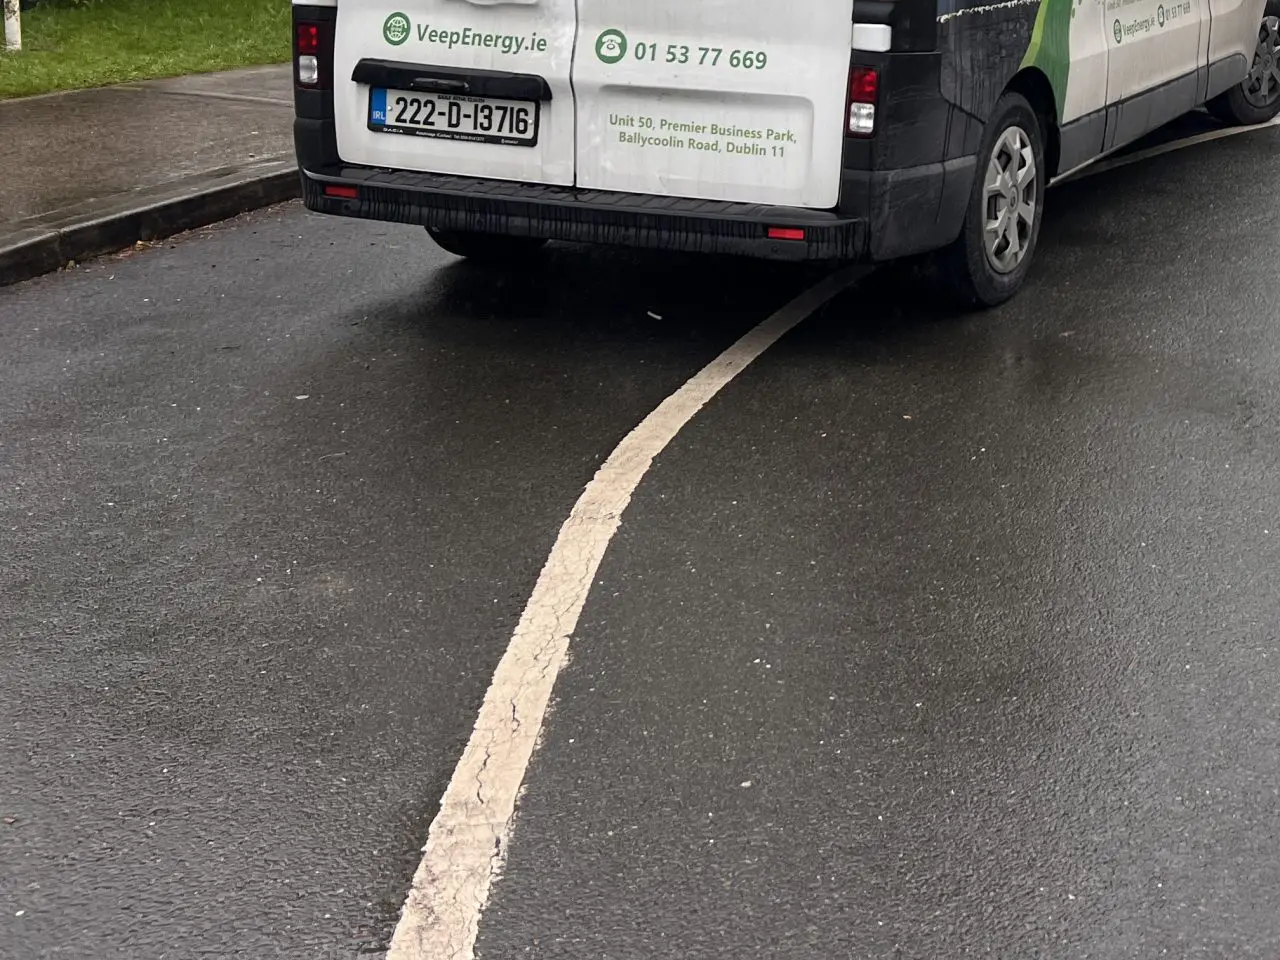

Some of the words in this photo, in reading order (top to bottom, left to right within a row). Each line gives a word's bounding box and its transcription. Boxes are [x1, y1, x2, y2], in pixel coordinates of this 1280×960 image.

[417, 24, 547, 54] VeepEnergy.ie
[1122, 16, 1155, 37] VeepEnergy.ie
[634, 42, 658, 61] 01
[665, 45, 690, 64] 53
[698, 47, 723, 66] 77
[729, 50, 768, 70] 669
[372, 110, 386, 120] IRL
[395, 96, 529, 135] 222-D-13716
[609, 113, 635, 128] Unit
[638, 117, 656, 132] 50,
[660, 119, 708, 134] Premier
[710, 123, 763, 140] Business
[766, 128, 798, 145] Park,
[619, 131, 684, 148] Ballycoolin
[688, 140, 722, 154] Road,
[726, 142, 767, 157] Dublin
[771, 146, 785, 158] 11
